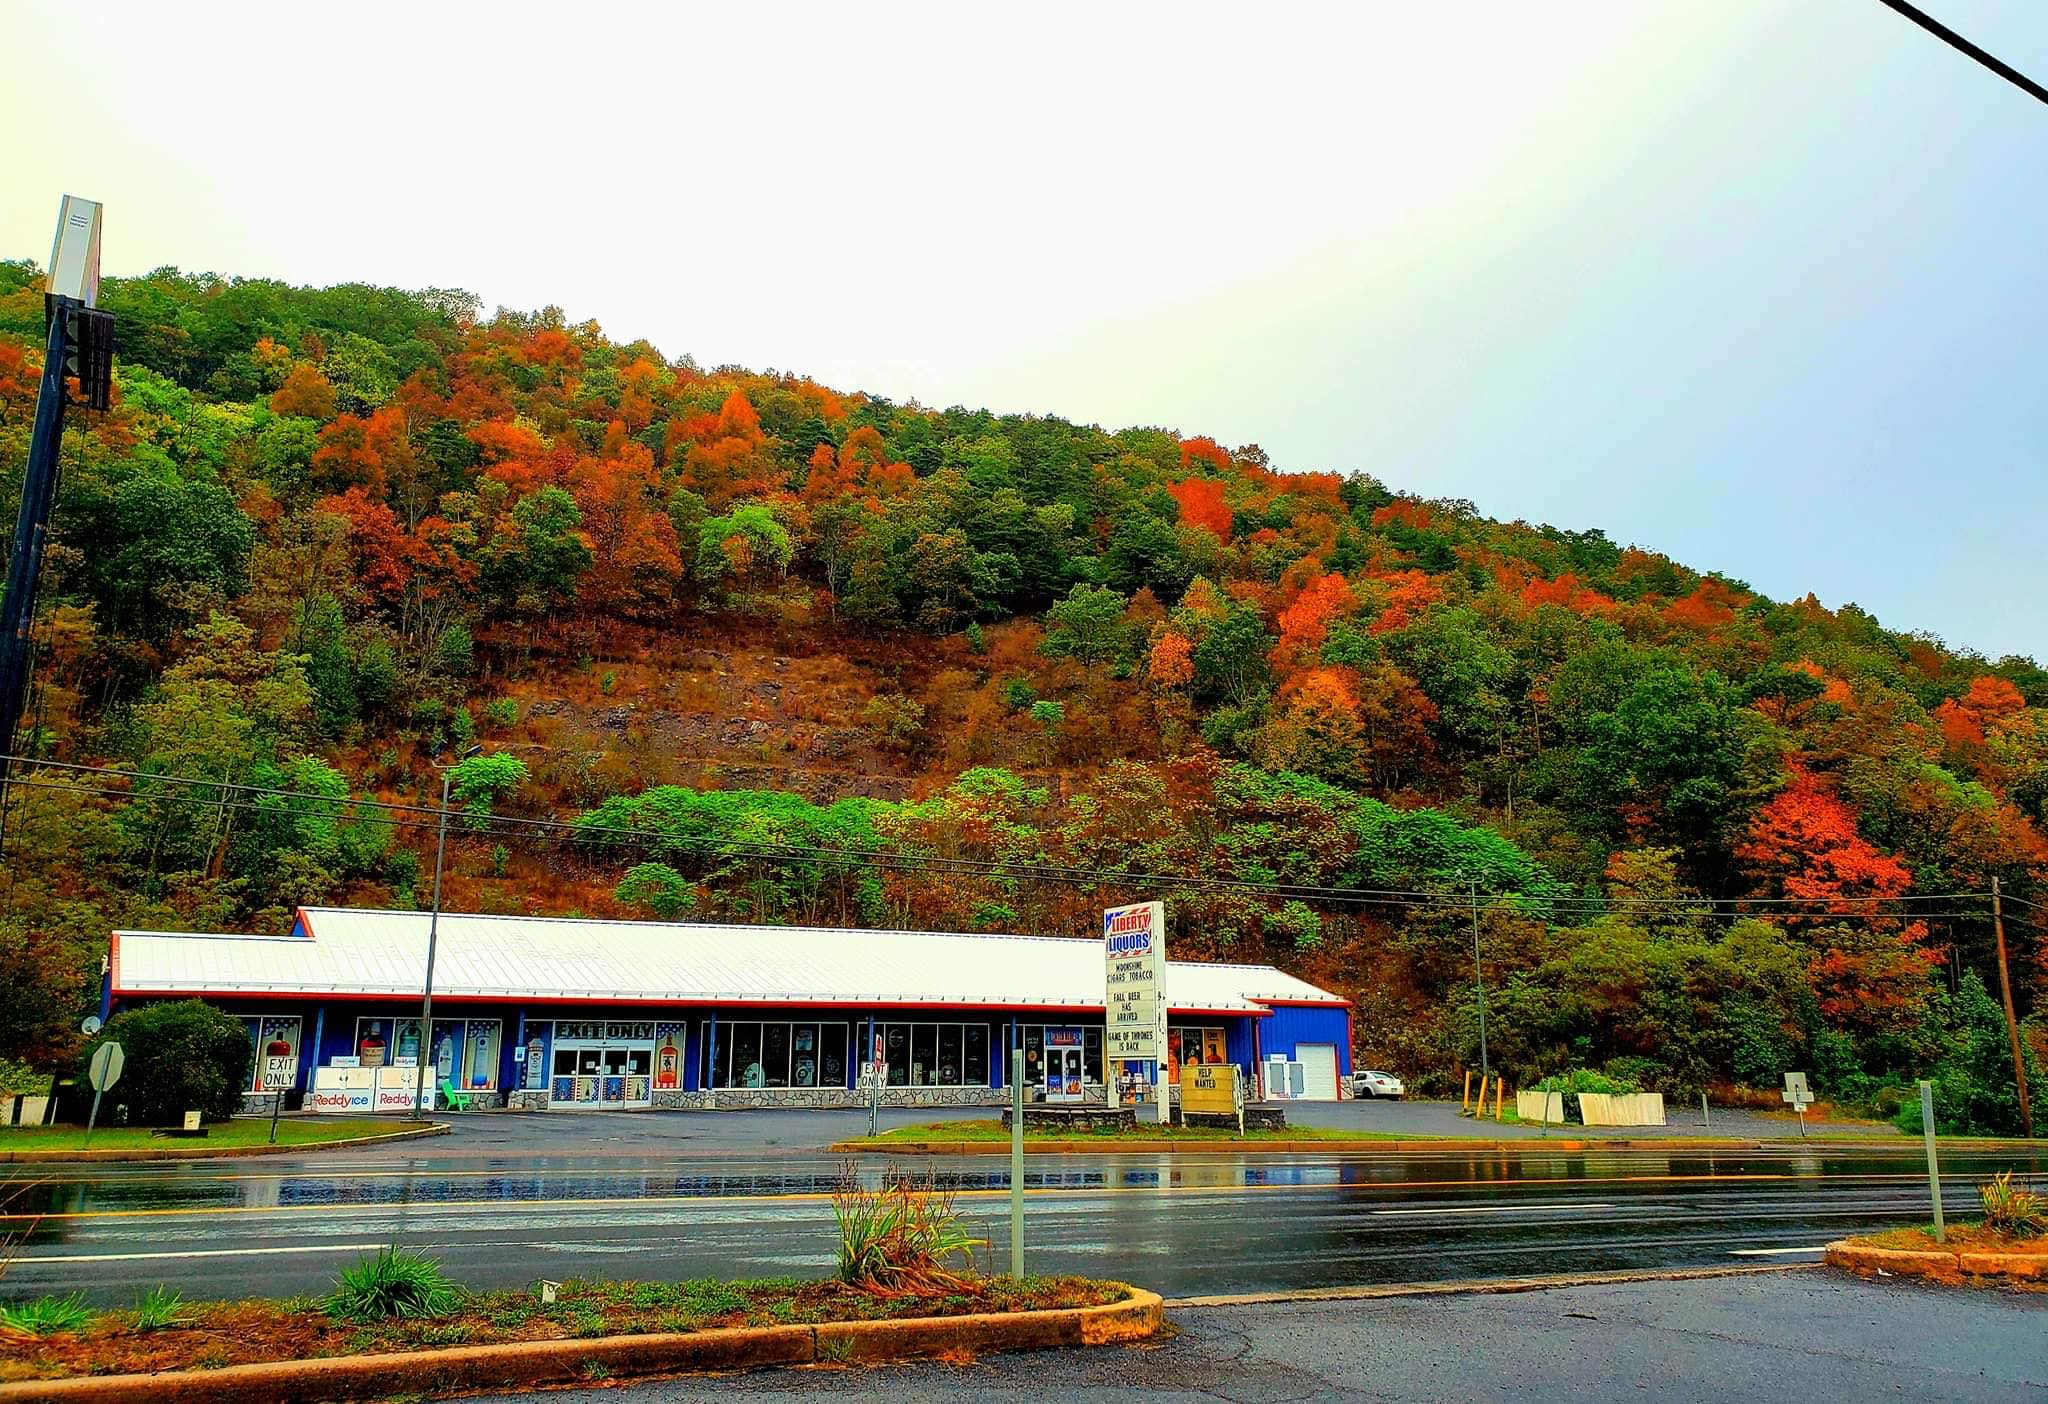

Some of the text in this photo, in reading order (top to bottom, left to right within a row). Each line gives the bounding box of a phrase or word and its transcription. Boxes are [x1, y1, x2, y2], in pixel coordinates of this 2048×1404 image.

[1112, 913, 1149, 932] LIBERTY
[1108, 933, 1149, 952] LIQUORS
[1129, 969, 1153, 981] TOBACCO
[1113, 991, 1141, 1002] FALL BEER
[1121, 1002, 1132, 1011] HAS
[1117, 1012, 1138, 1021] ARRIVED
[558, 1023, 653, 1039] EXIT ONLY
[1123, 1031, 1129, 1040] OF
[1131, 1031, 1153, 1040] THRONES
[1126, 1041, 1139, 1051] BACK
[269, 1058, 295, 1070] EXIT
[865, 1063, 885, 1074] EXT
[1198, 1068, 1212, 1078] HELP
[265, 1073, 295, 1086] ONLY
[861, 1075, 886, 1088] ONY
[1194, 1079, 1216, 1089] WANTED
